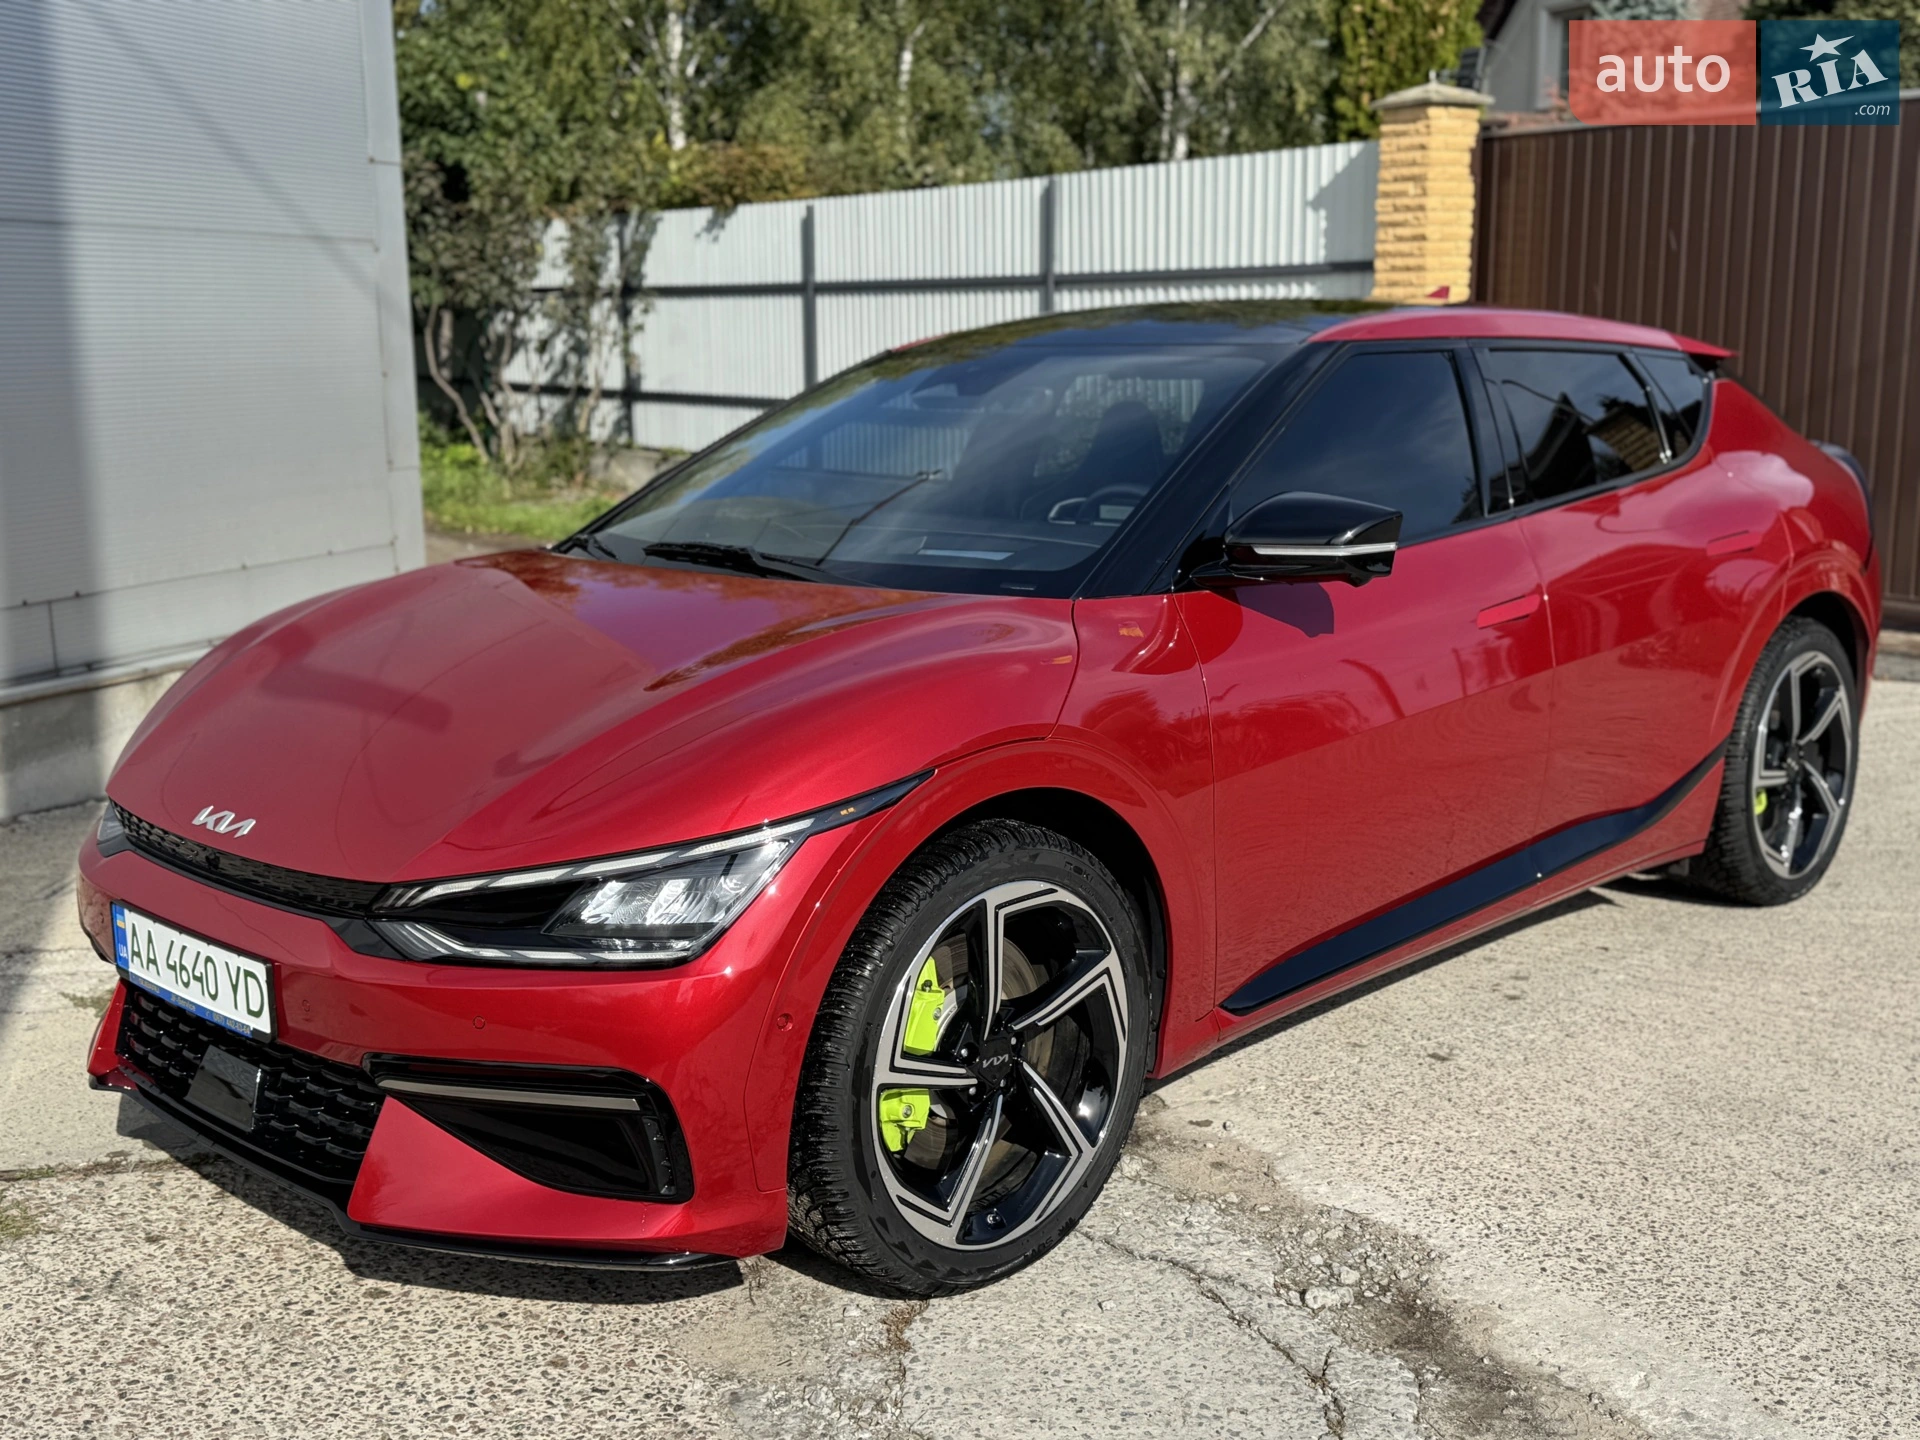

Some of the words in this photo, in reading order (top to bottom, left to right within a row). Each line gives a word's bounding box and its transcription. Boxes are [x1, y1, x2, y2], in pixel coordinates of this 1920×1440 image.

[118, 944, 128, 959] UA
[131, 922, 161, 977] AA
[165, 939, 219, 1002] 4640
[225, 961, 265, 1019] YD
